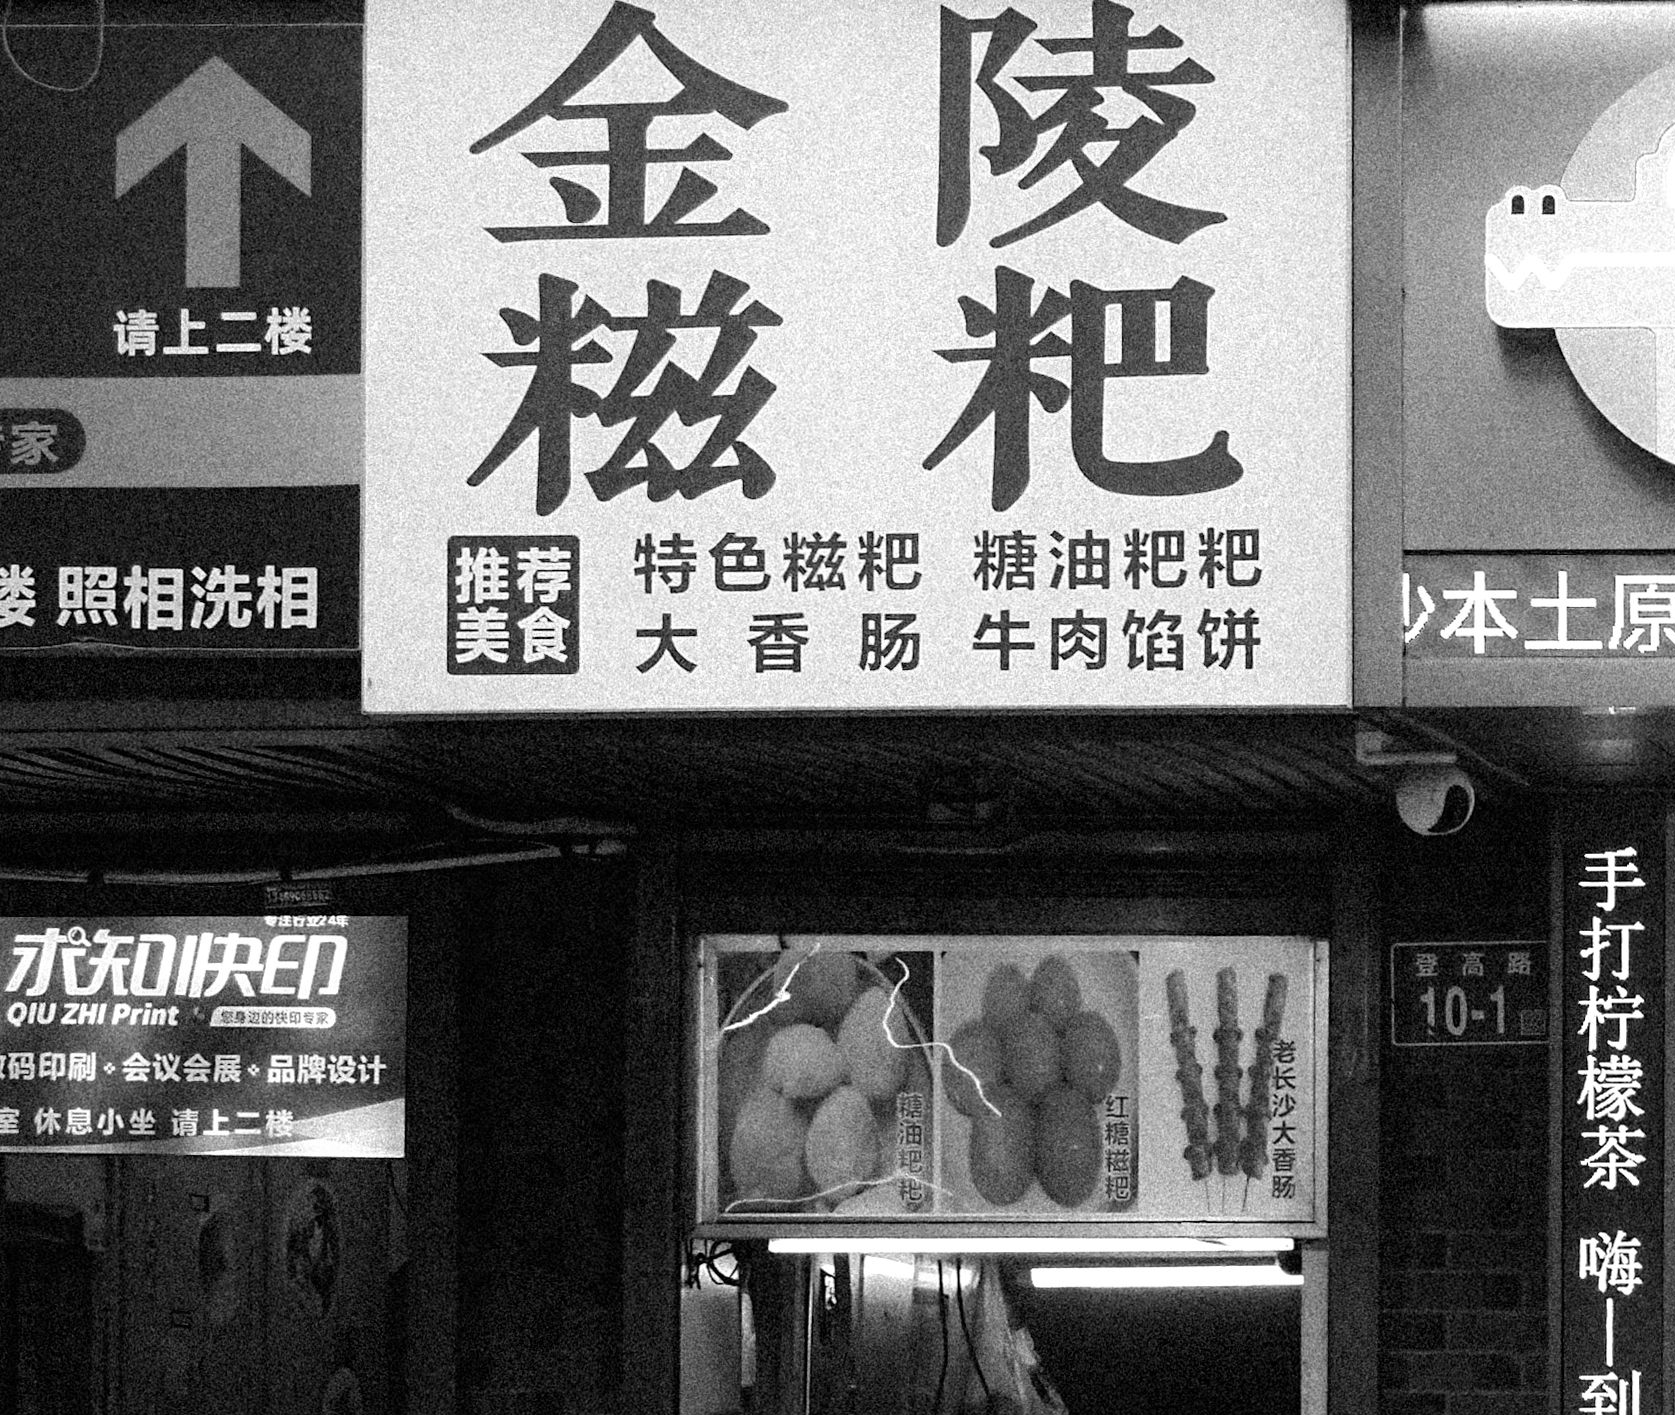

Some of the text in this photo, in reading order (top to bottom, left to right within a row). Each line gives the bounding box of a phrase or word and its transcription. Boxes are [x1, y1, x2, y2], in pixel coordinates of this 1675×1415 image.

[468, 0, 1229, 249] 金陵
[113, 307, 314, 358] 请上二楼
[466, 264, 1245, 518] 糍粑
[0, 420, 59, 466] 家
[455, 547, 573, 604] 推荐
[634, 527, 1263, 594] 特色糍粑 糖油粑粑
[57, 564, 318, 631] 照相洗相
[454, 606, 571, 666] 美食
[634, 608, 1262, 674] 大香肠 牛肉馅饼
[1415, 951, 1532, 978] 登高路
[6, 1002, 180, 1028] QIU ZHI Print
[1419, 984, 1505, 1037] 10-1
[1577, 845, 1646, 1191] 手打柠檬茶
[0, 1051, 389, 1086] 码印刷 会议会展 品牌设计
[33, 1107, 158, 1137] 休息小坐
[170, 1108, 295, 1138] 请上二楼
[897, 1092, 924, 1203] 糖油粑粑
[1104, 1095, 1132, 1202] 红糖糍粑
[1271, 1040, 1298, 1201] 老长沙大香肠
